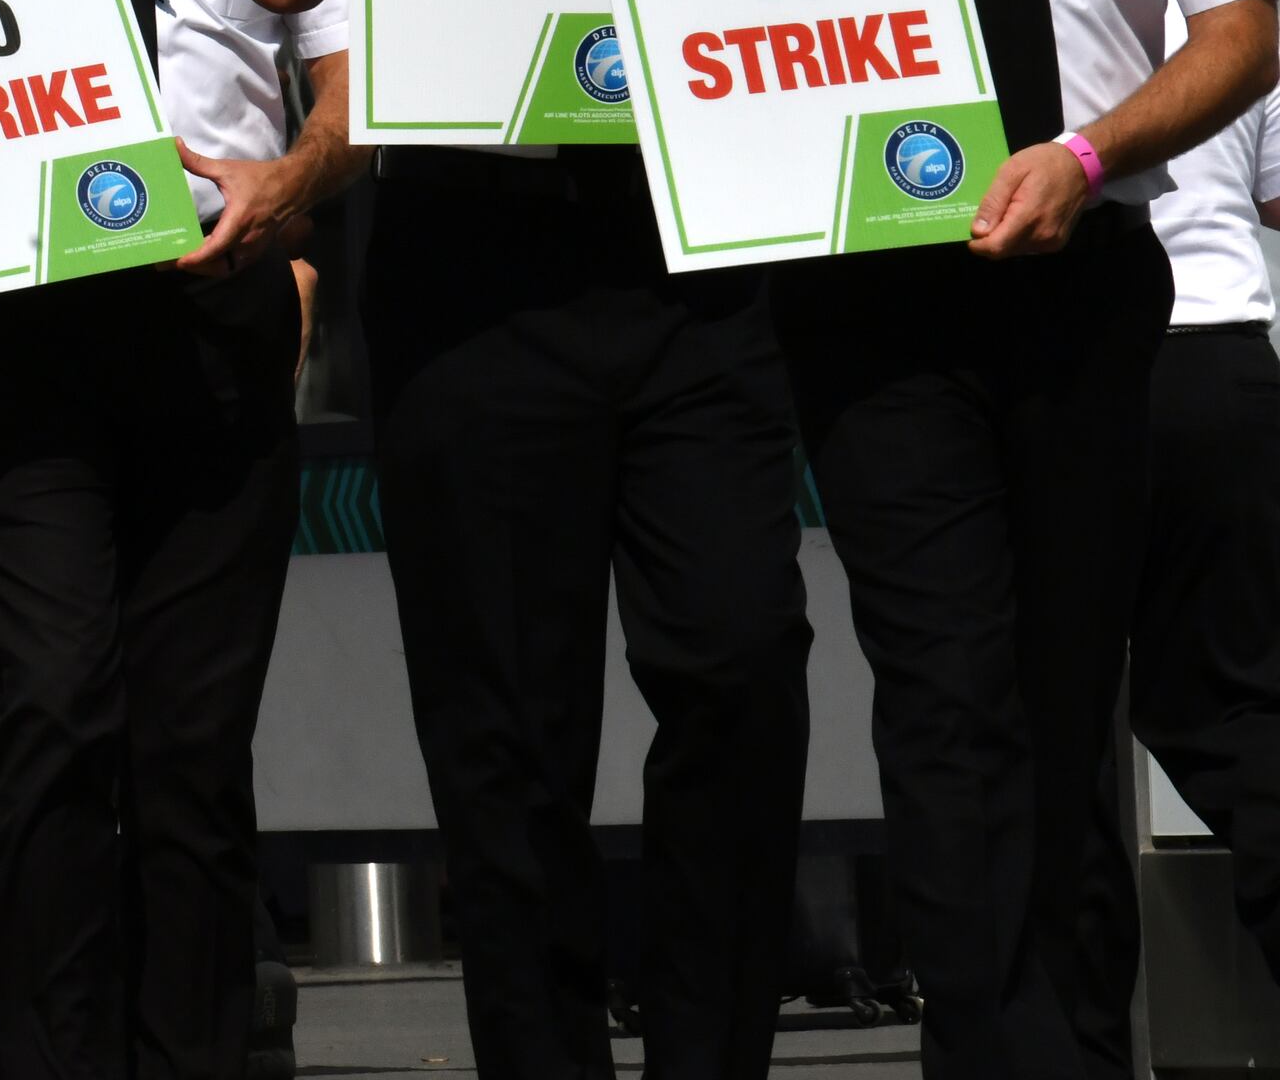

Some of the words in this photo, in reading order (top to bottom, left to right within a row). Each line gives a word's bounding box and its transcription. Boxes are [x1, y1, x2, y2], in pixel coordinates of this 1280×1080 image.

[592, 28, 616, 41] DEL
[683, 10, 939, 99] STRIKE
[578, 66, 594, 92] MASTER
[896, 123, 937, 138] DELTA
[87, 163, 122, 178] DELTA
[925, 163, 946, 174] alpa
[890, 166, 911, 190] MASTER
[911, 187, 949, 197] EXECUTIVE
[948, 159, 961, 187] COUNCIL
[83, 202, 102, 223] MASTER
[103, 216, 136, 227] EXECUTIVE
[134, 192, 145, 217] COUNCIL
[113, 197, 132, 208] alpa
